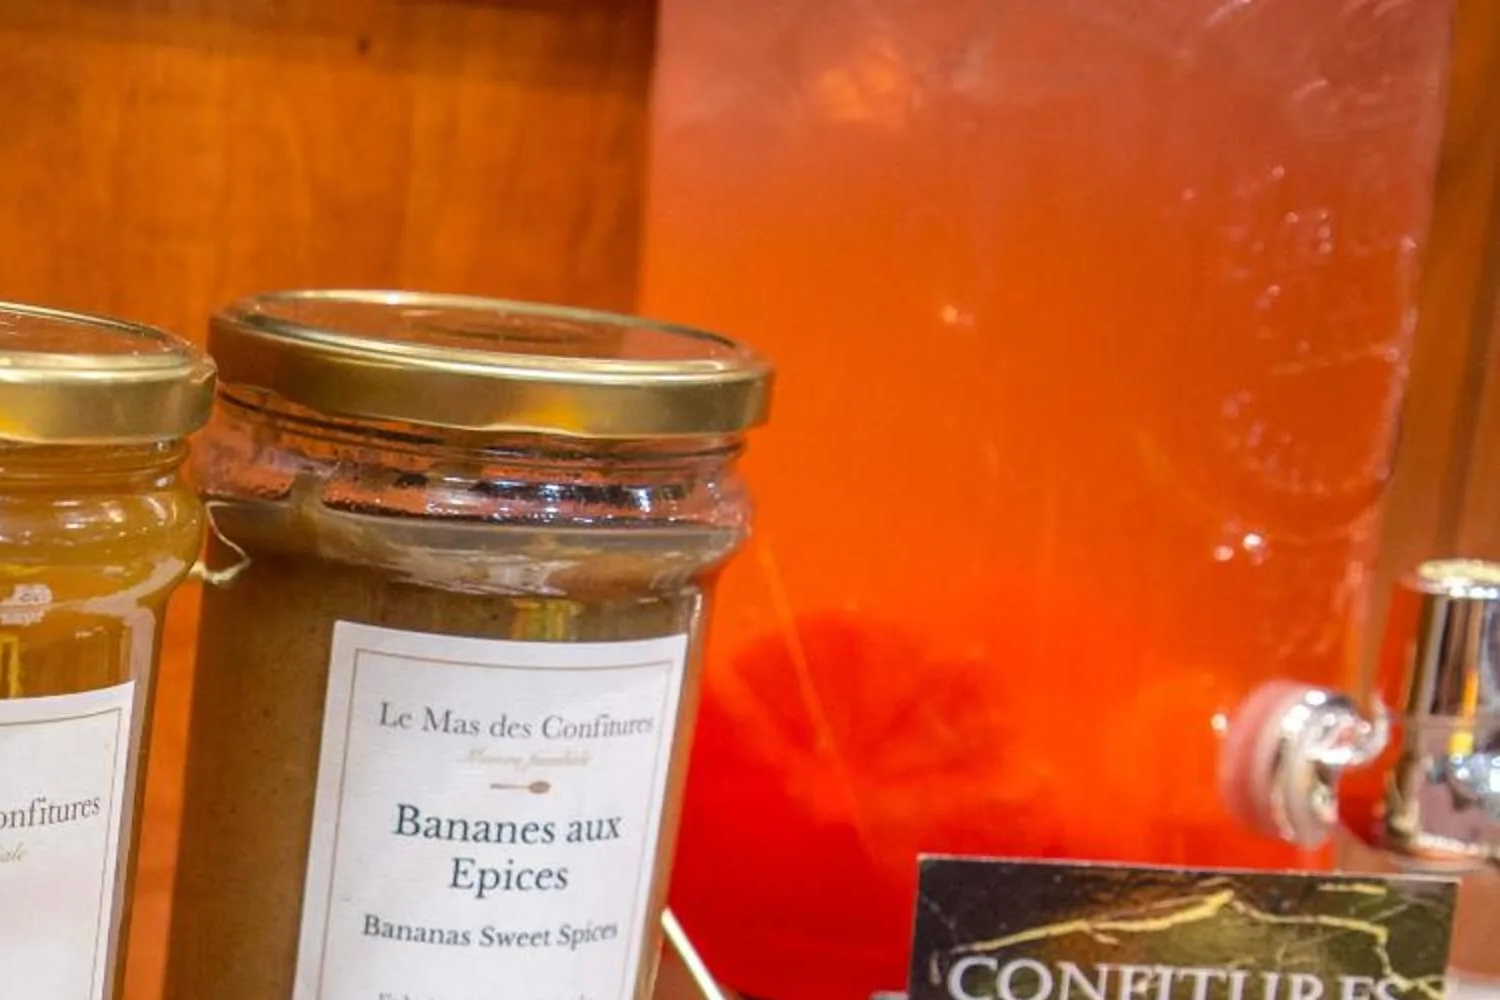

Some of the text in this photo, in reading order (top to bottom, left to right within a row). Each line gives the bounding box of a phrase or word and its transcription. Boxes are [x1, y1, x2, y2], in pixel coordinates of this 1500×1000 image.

[378, 701, 655, 741] Le Mas des Confitures
[393, 803, 623, 845] Bananes aux
[448, 857, 569, 900] Epices
[362, 913, 619, 951] Bananas Sweet Spices
